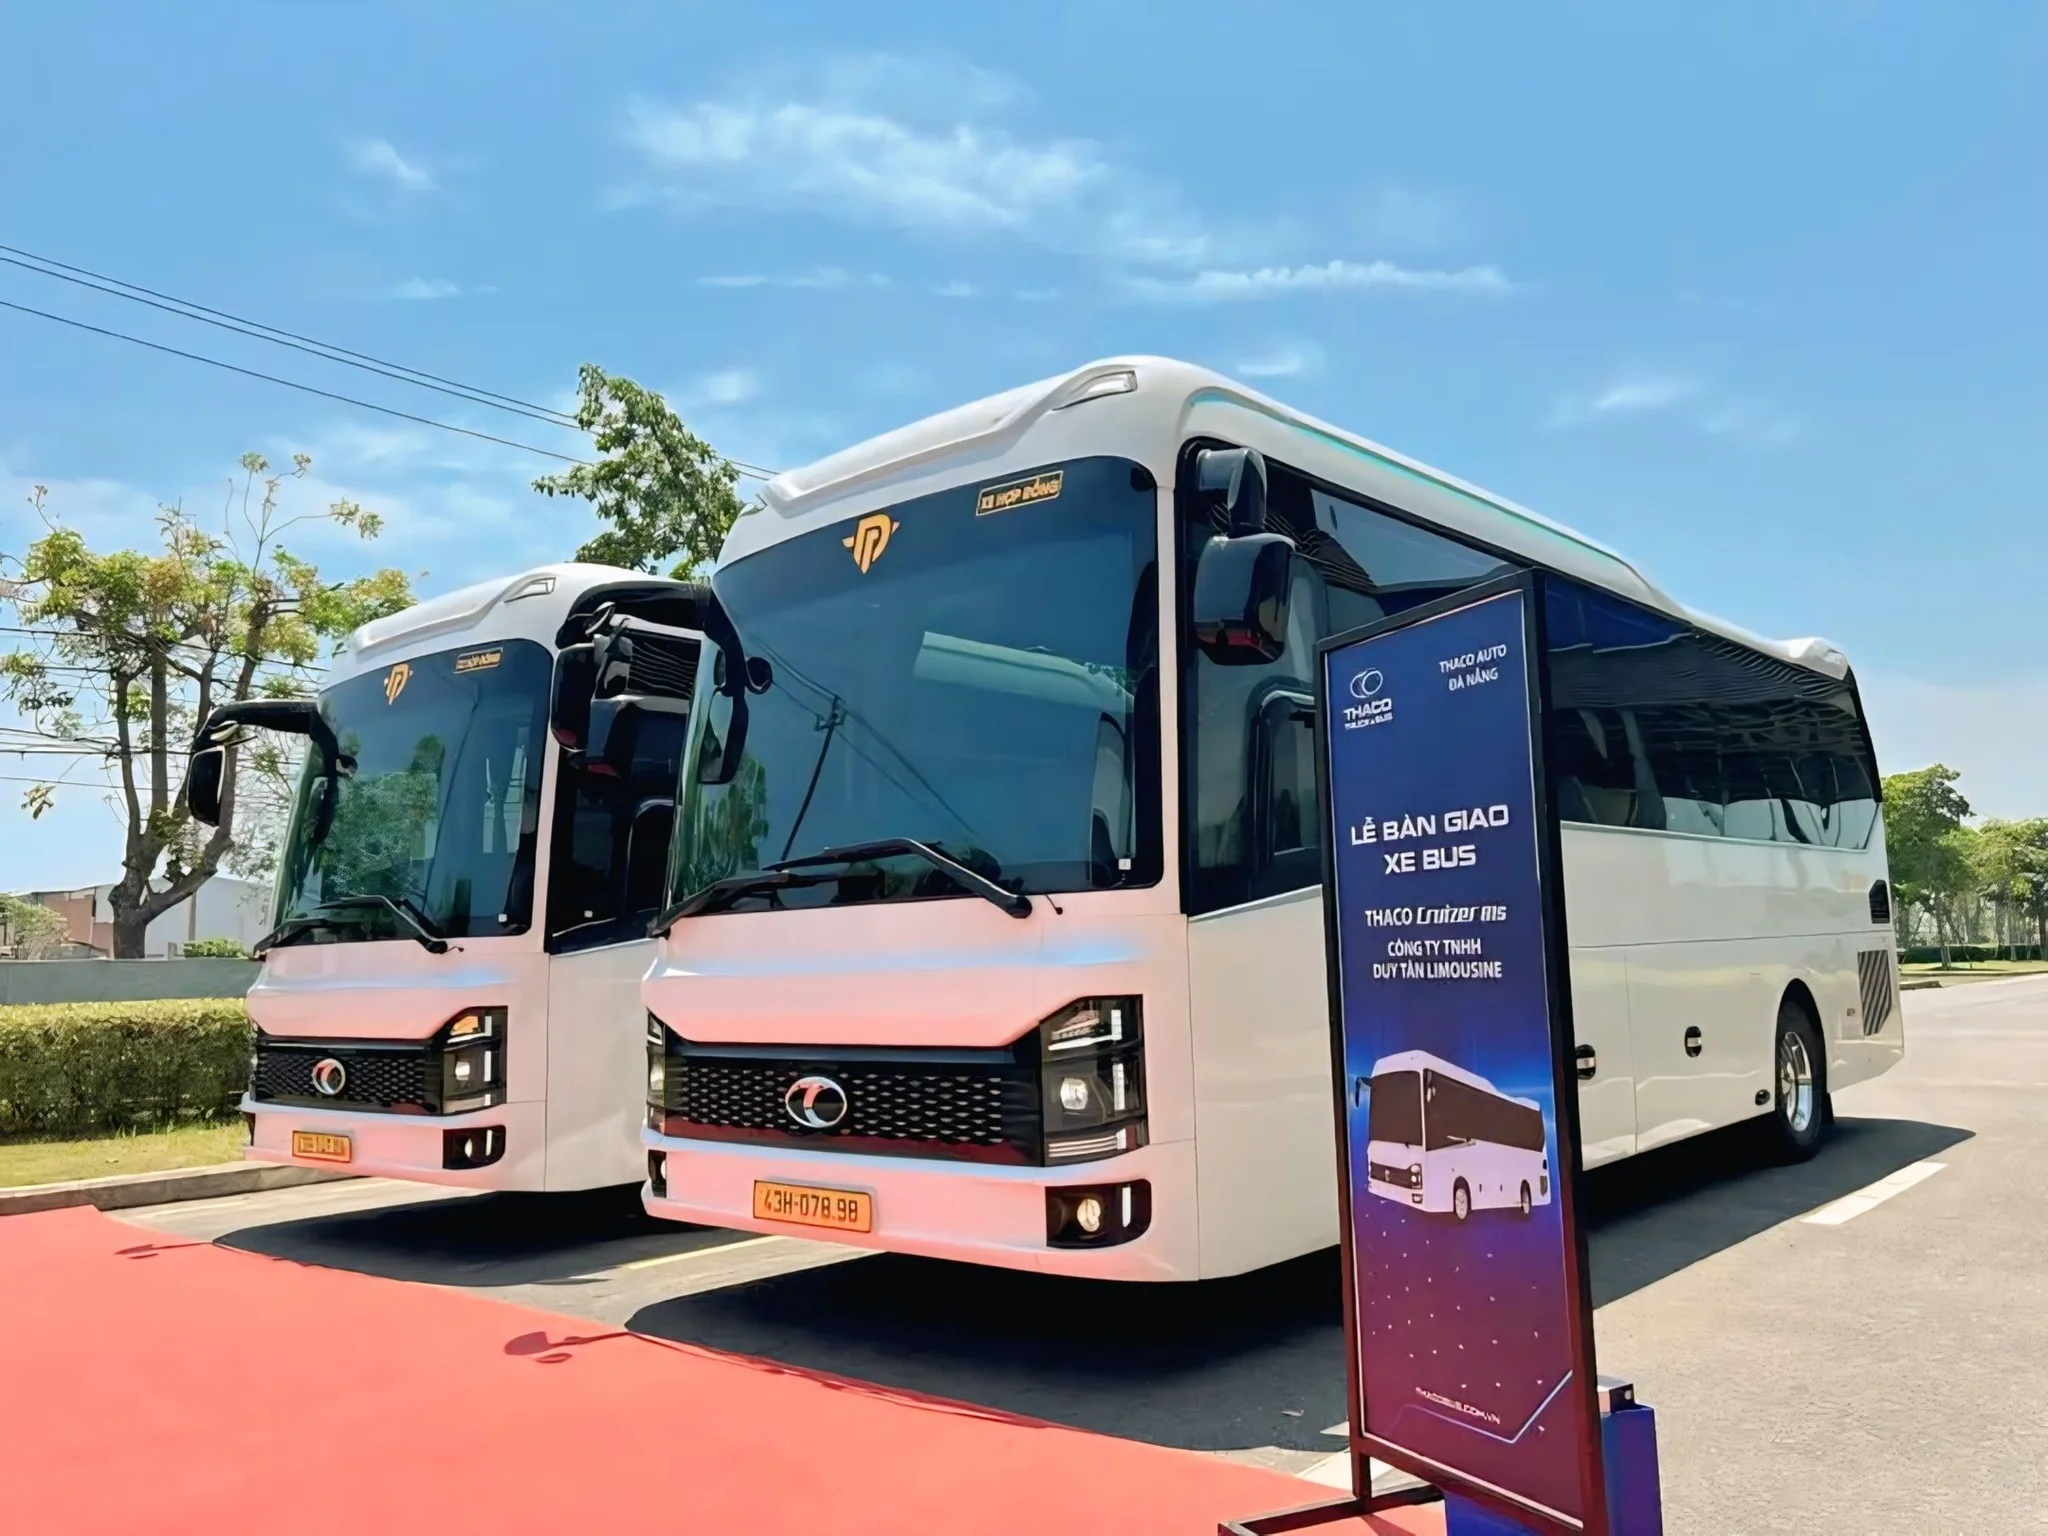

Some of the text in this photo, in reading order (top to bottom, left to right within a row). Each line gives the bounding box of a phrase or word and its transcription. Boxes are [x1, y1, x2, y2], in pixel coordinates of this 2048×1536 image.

[1476, 643, 1507, 664] AUTO
[1343, 698, 1392, 721] THACO
[1351, 804, 1509, 846] LỄ BÀN GIAO
[1383, 844, 1476, 875] XE BUS
[1365, 907, 1413, 927] THACO
[1387, 938, 1482, 957] CÔNG TY TNHH
[1373, 963, 1398, 979] DUY
[1427, 961, 1502, 979] LIMOUSINE
